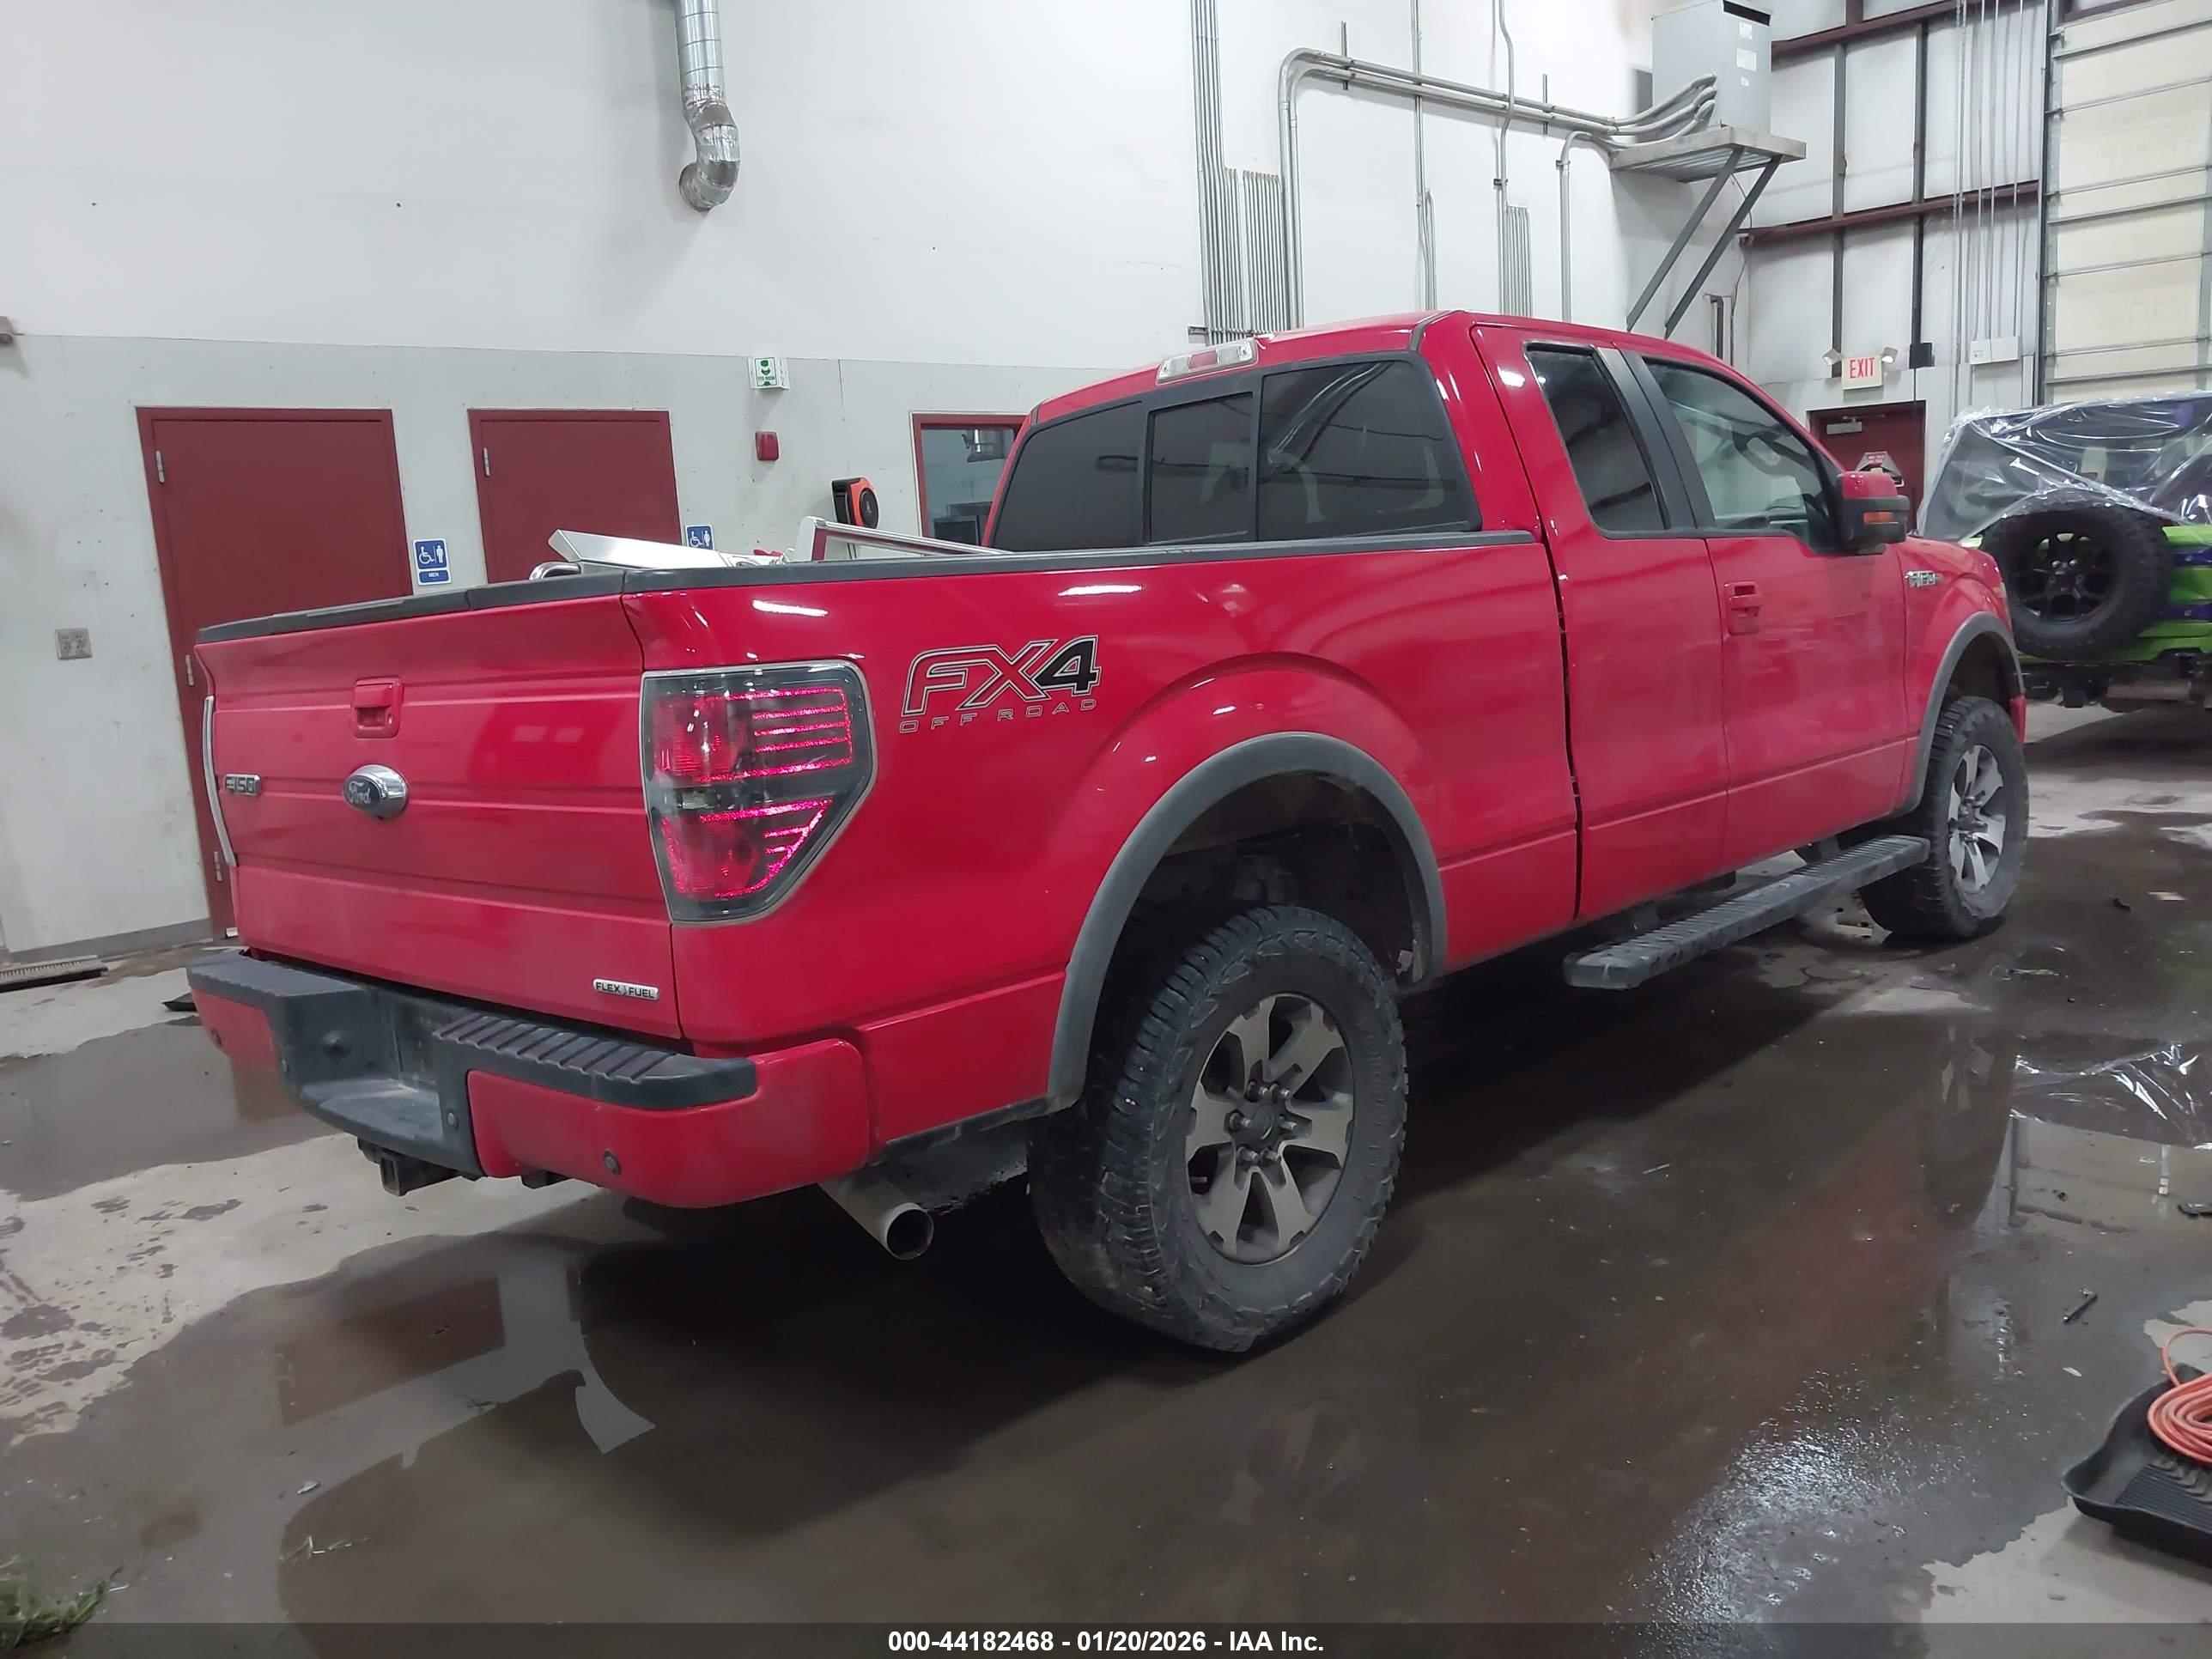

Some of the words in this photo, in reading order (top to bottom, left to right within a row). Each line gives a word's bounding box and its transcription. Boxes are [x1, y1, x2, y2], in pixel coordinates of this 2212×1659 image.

[1850, 356, 1875, 379] EXIT
[901, 635, 1103, 718] FX4
[899, 712, 978, 734] OFF
[997, 698, 1097, 722] ROAD
[348, 780, 372, 805] Ford
[595, 981, 621, 994] FLEX
[628, 987, 655, 999] FUEL
